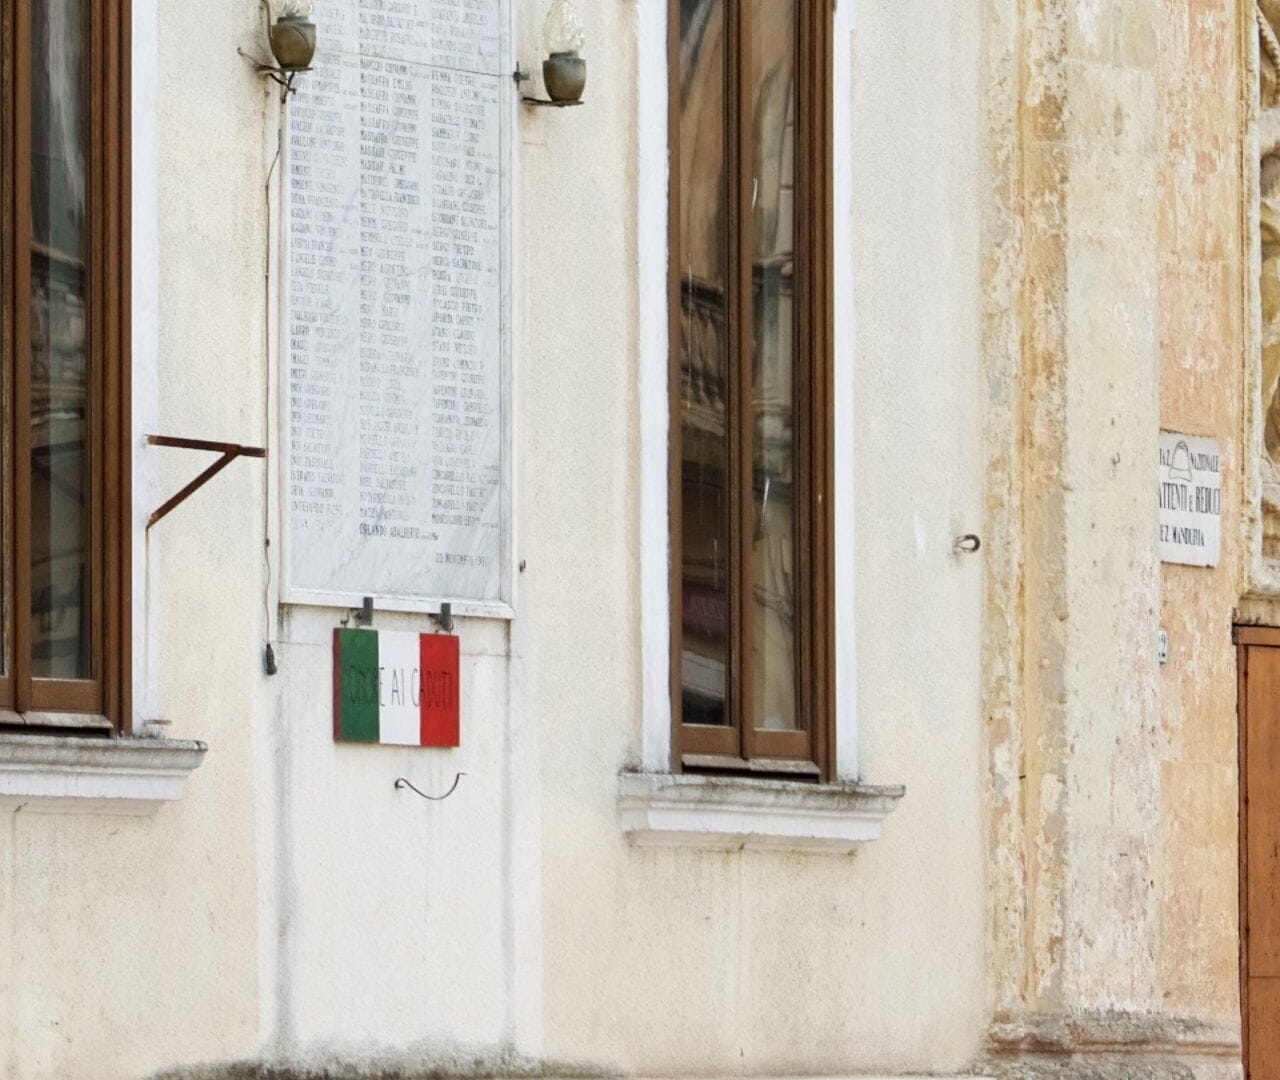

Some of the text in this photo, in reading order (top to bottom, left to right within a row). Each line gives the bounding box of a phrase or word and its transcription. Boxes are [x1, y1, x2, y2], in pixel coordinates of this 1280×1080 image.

[1190, 452, 1219, 472] NAZIONALE
[1195, 487, 1220, 515] REDUCI
[1172, 526, 1205, 546] MANDURIA
[391, 668, 404, 706] AI
